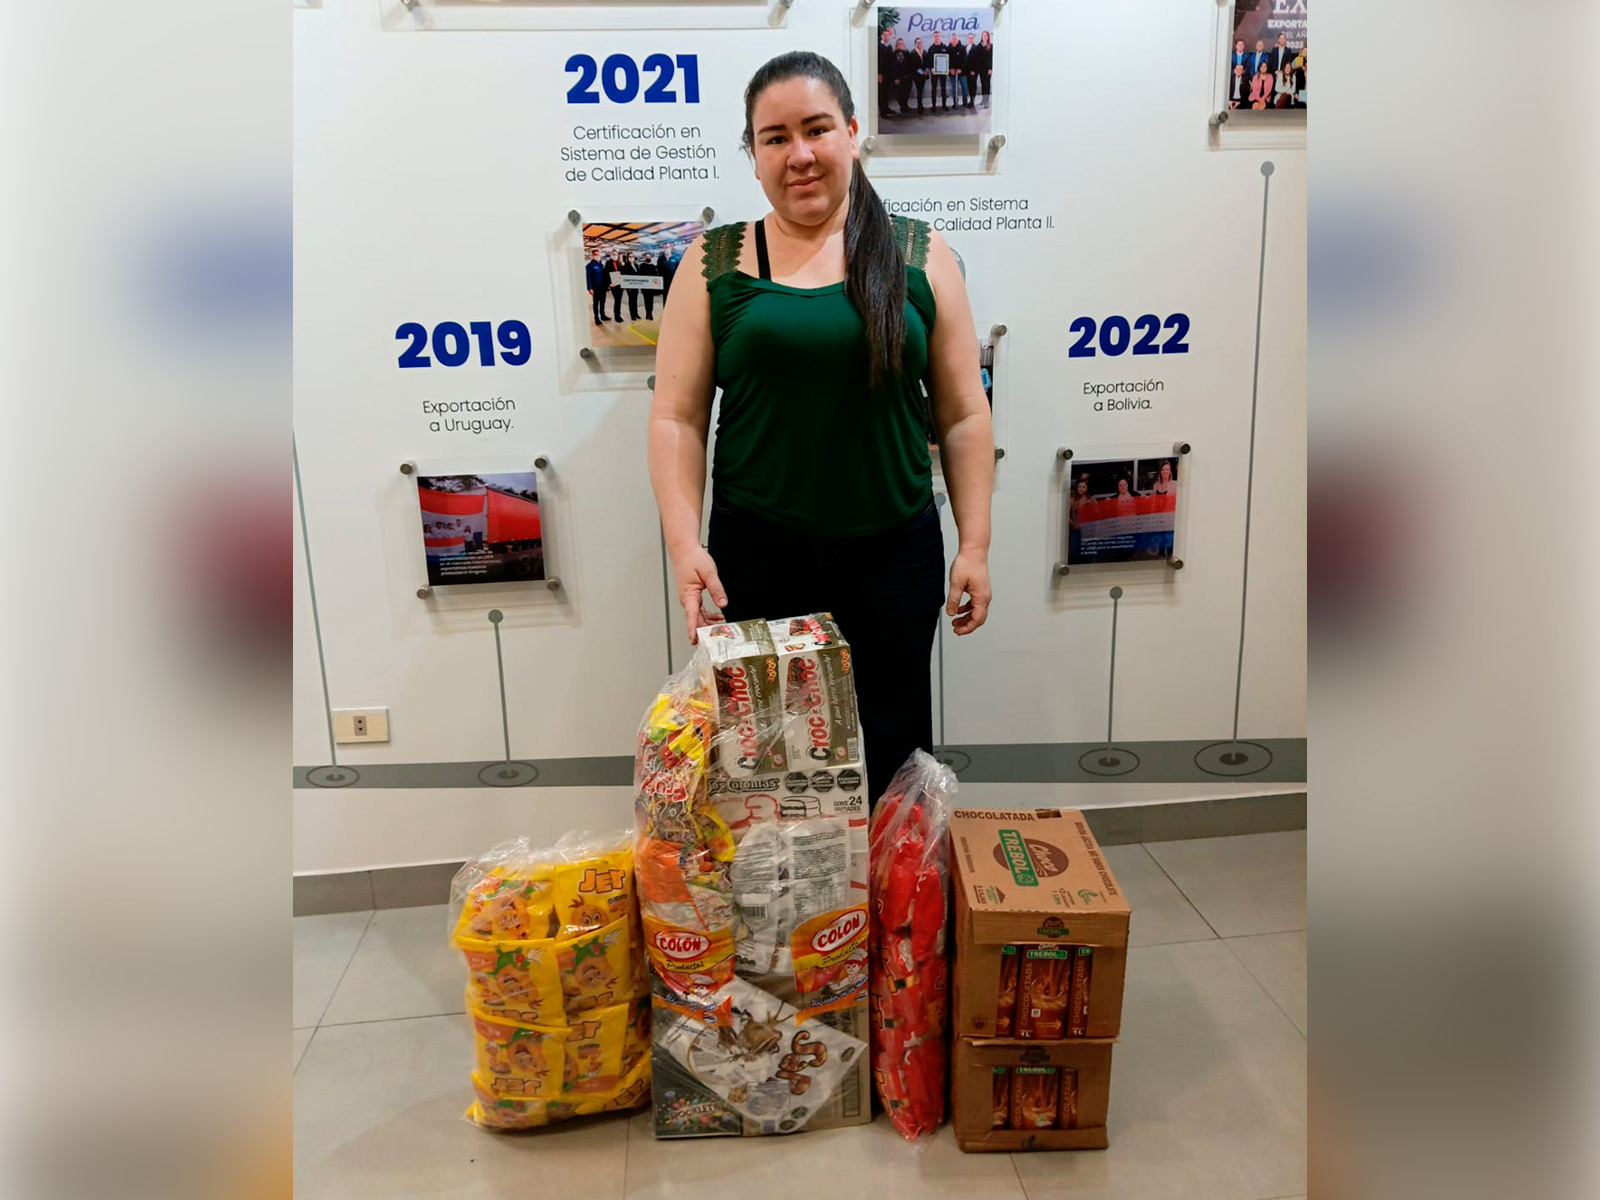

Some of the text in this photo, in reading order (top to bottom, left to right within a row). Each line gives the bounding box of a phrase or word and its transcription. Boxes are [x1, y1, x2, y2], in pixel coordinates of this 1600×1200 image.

[564, 53, 700, 104] 2021
[573, 124, 701, 140] Certificación en
[560, 144, 716, 161] Sistema de Gestión
[565, 167, 587, 182] de
[591, 166, 655, 182] Calidad
[659, 165, 709, 181] Planta
[947, 198, 966, 212] en
[969, 197, 1029, 212] Sistema
[933, 217, 992, 232] Calidad
[996, 216, 1043, 230] Planta
[395, 319, 532, 369] 2019
[1068, 312, 1190, 358] 2022
[1083, 378, 1165, 398] Exportación
[422, 397, 516, 417] Exportación
[1093, 397, 1152, 411] a Bolivia.
[429, 418, 514, 435] a Uruguay.
[849, 796, 863, 806] 24
[954, 810, 1035, 822] CHOCOLATADA
[1002, 831, 1025, 874] TREBOL
[1029, 844, 1059, 873] Choco
[577, 868, 627, 894] JET
[817, 914, 860, 949] COLON
[660, 937, 702, 953] COLON
[1021, 962, 1033, 1027] CHOCOLATADA
[1073, 959, 1085, 1024] CHOCOLATADA
